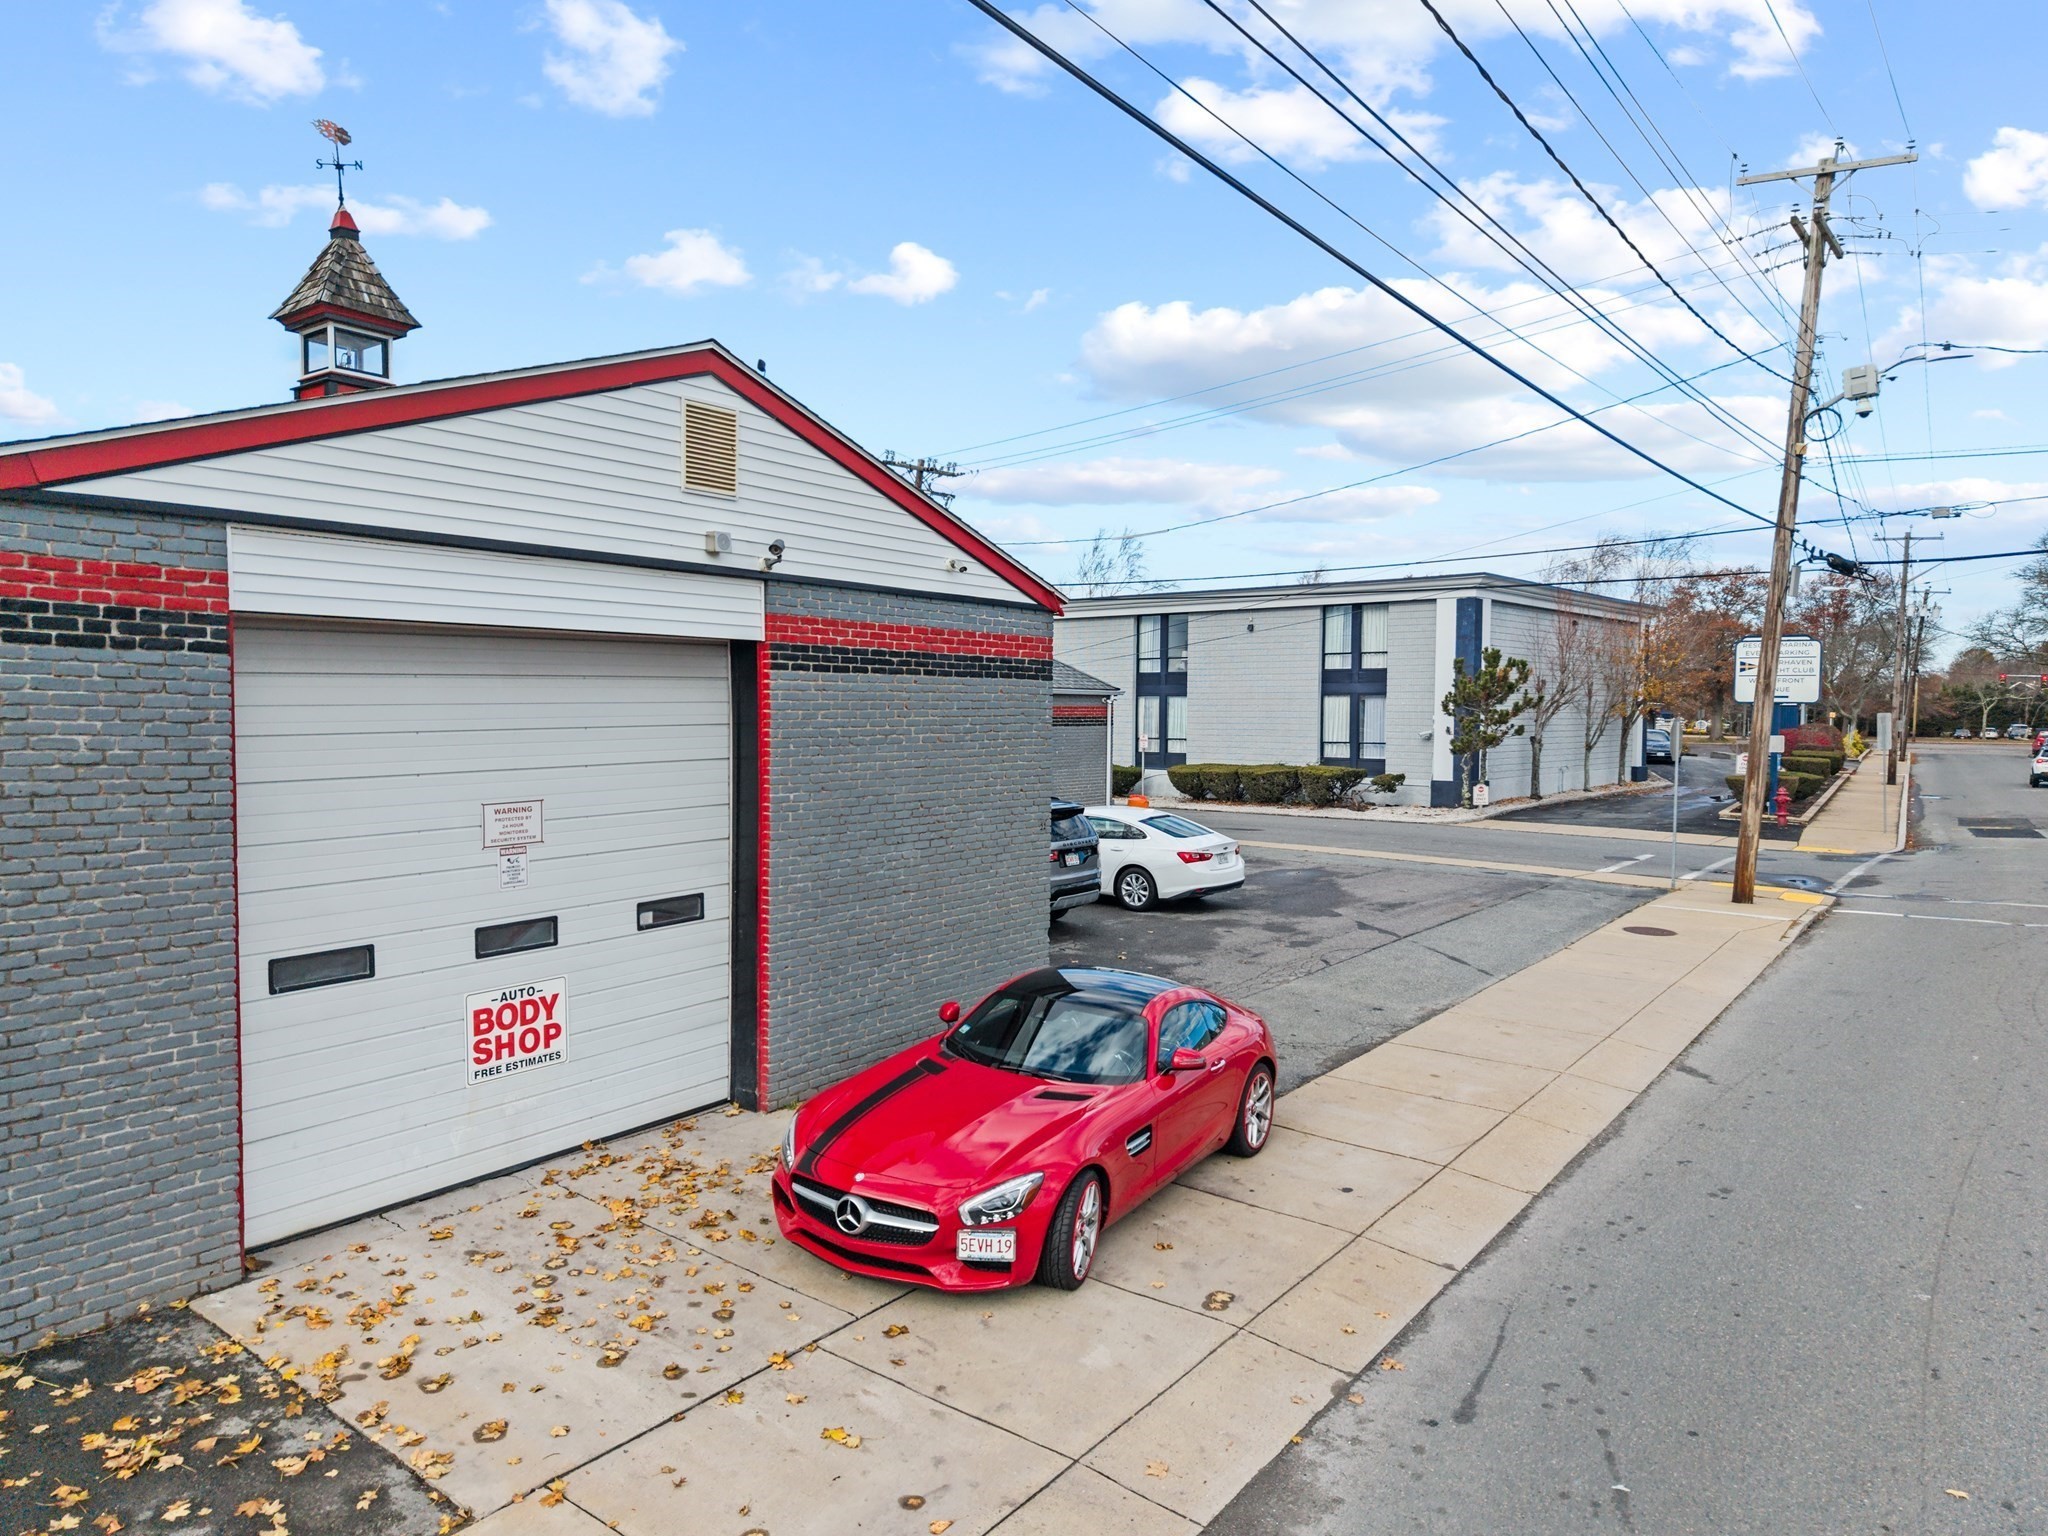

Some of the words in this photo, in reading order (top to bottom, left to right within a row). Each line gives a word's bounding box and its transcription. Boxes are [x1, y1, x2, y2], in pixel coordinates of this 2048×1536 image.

[316, 158, 323, 170] S
[355, 160, 363, 171] N
[494, 806, 533, 815] WARNING
[473, 993, 560, 1037] BODY
[473, 1023, 562, 1065] SHOP
[474, 1065, 503, 1079] FREE
[505, 1051, 562, 1072] ESTIMATES
[961, 1238, 993, 1252] 5EVH
[996, 1239, 1013, 1254] 19
